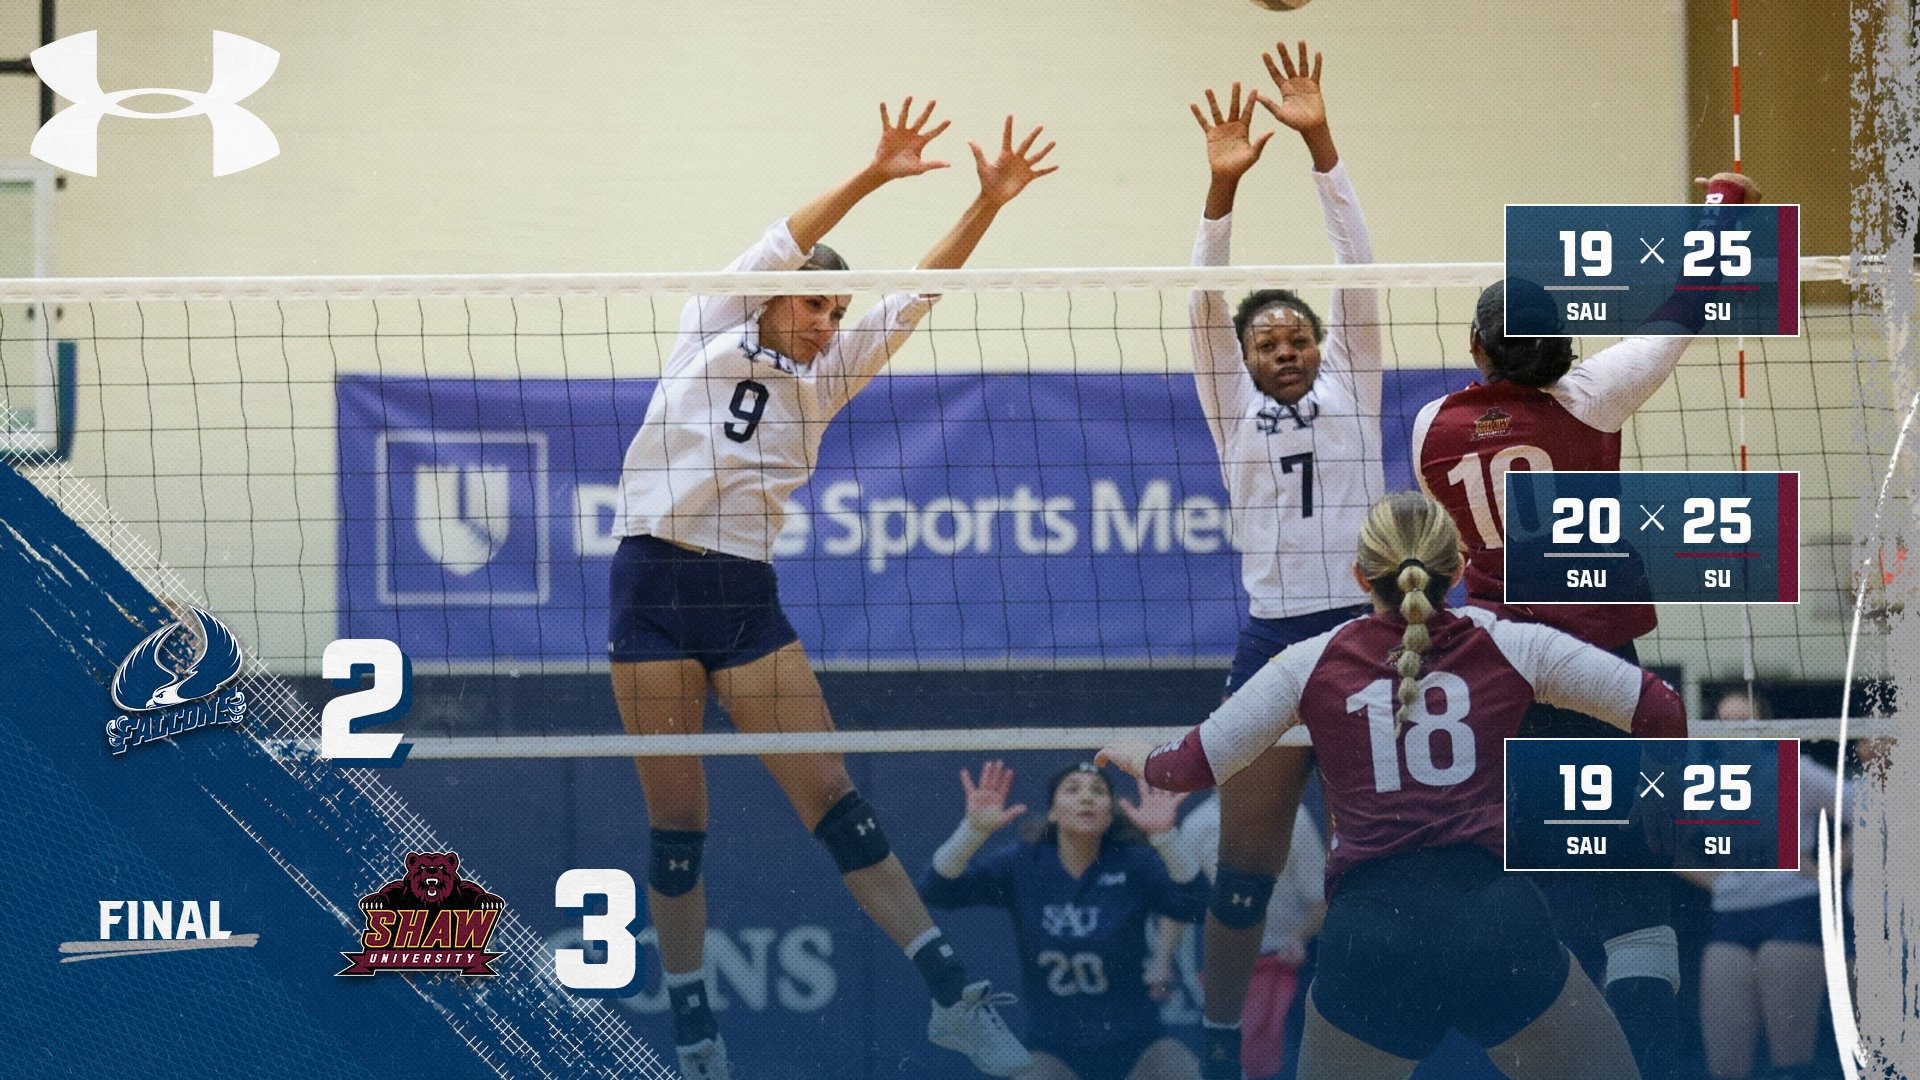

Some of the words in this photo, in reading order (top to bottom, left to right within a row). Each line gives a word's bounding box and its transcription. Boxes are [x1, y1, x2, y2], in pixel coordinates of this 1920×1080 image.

[724, 379, 770, 444] 9
[1280, 452, 1314, 518] 7
[1447, 445, 1557, 549] 10
[821, 479, 1078, 574] Sports
[1091, 477, 1243, 555] Me
[1345, 671, 1477, 793] 18
[1043, 902, 1099, 937] SAU
[1037, 951, 1109, 997] 20
